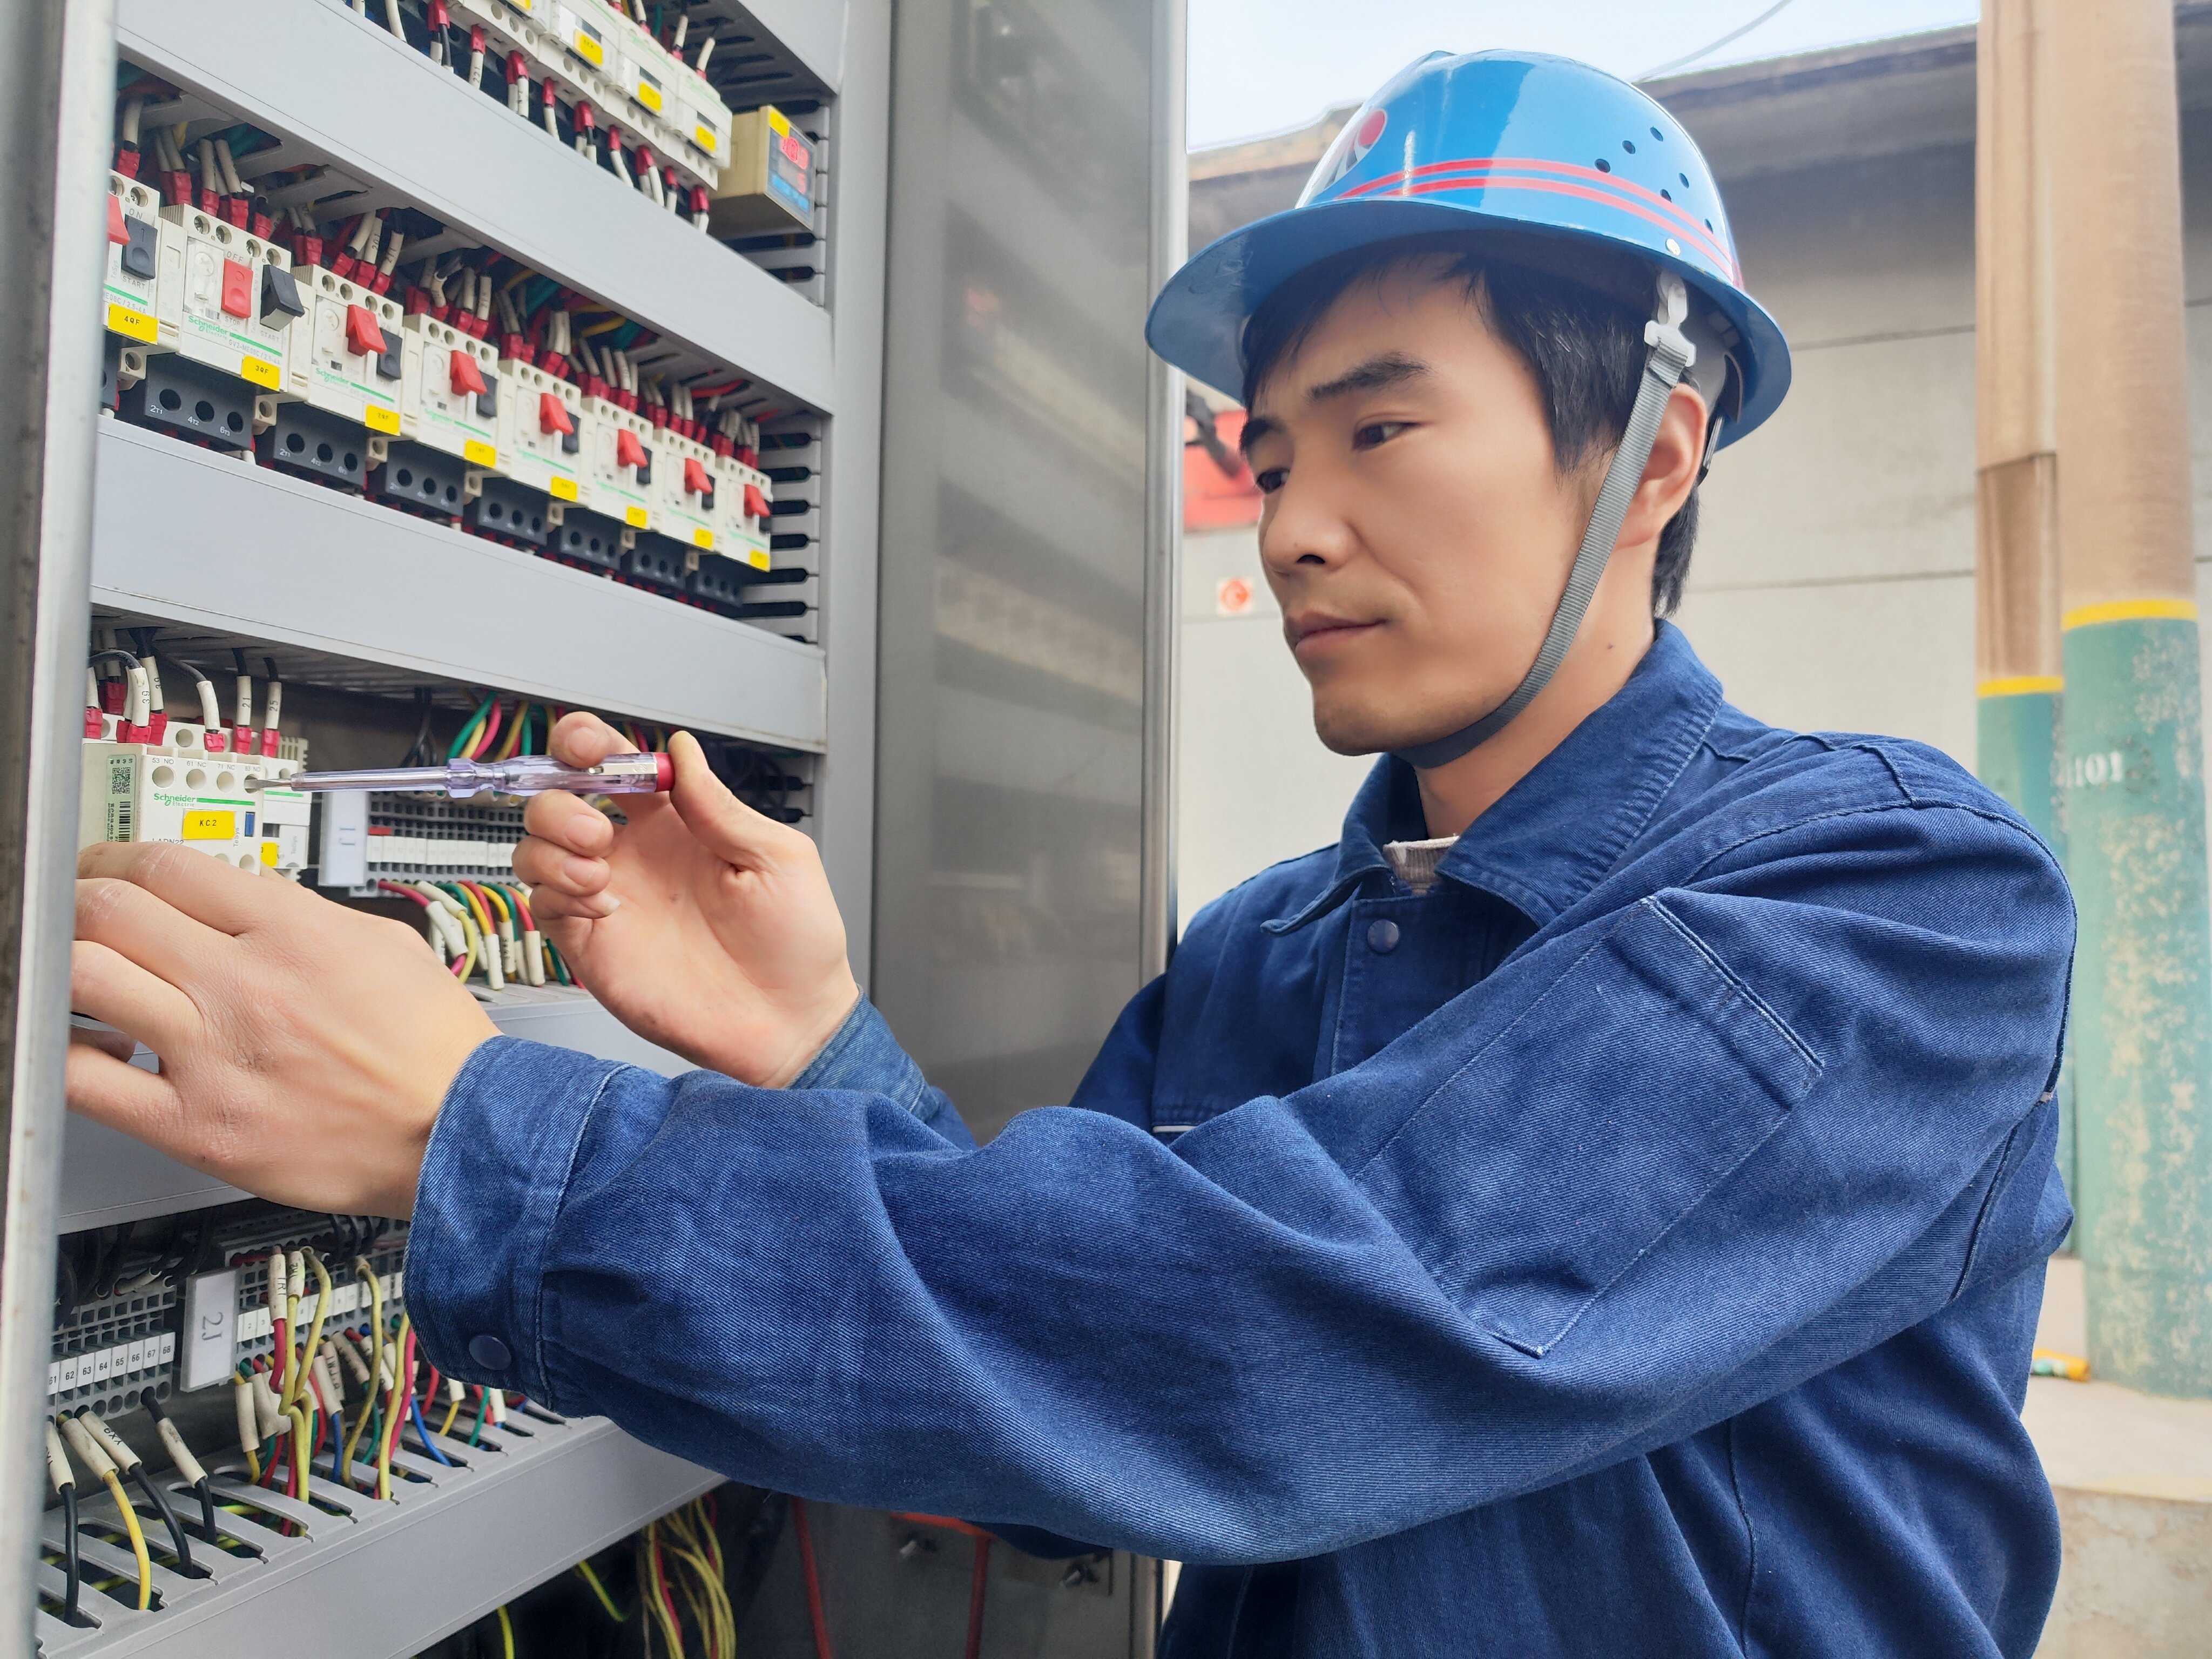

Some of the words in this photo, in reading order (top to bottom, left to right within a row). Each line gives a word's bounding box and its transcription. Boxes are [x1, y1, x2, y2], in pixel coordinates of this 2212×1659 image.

[129, 208, 143, 220] ON
[226, 251, 244, 263] OFF
[123, 276, 146, 290] START
[124, 315, 140, 325] 4QF
[188, 315, 229, 335] Schneider
[225, 316, 241, 326] STOP
[260, 331, 280, 343] START
[255, 365, 269, 374] 3QF
[141, 691, 150, 704] 39
[242, 697, 251, 708] 21
[270, 701, 278, 712] 25
[153, 793, 196, 802] Schneider
[147, 1349, 156, 1358] 67
[163, 1345, 171, 1354] 68
[116, 1358, 124, 1367] 65
[131, 1353, 140, 1363] 66
[83, 1366, 92, 1375] 63
[99, 1362, 108, 1371] 64
[65, 1372, 75, 1380] 62
